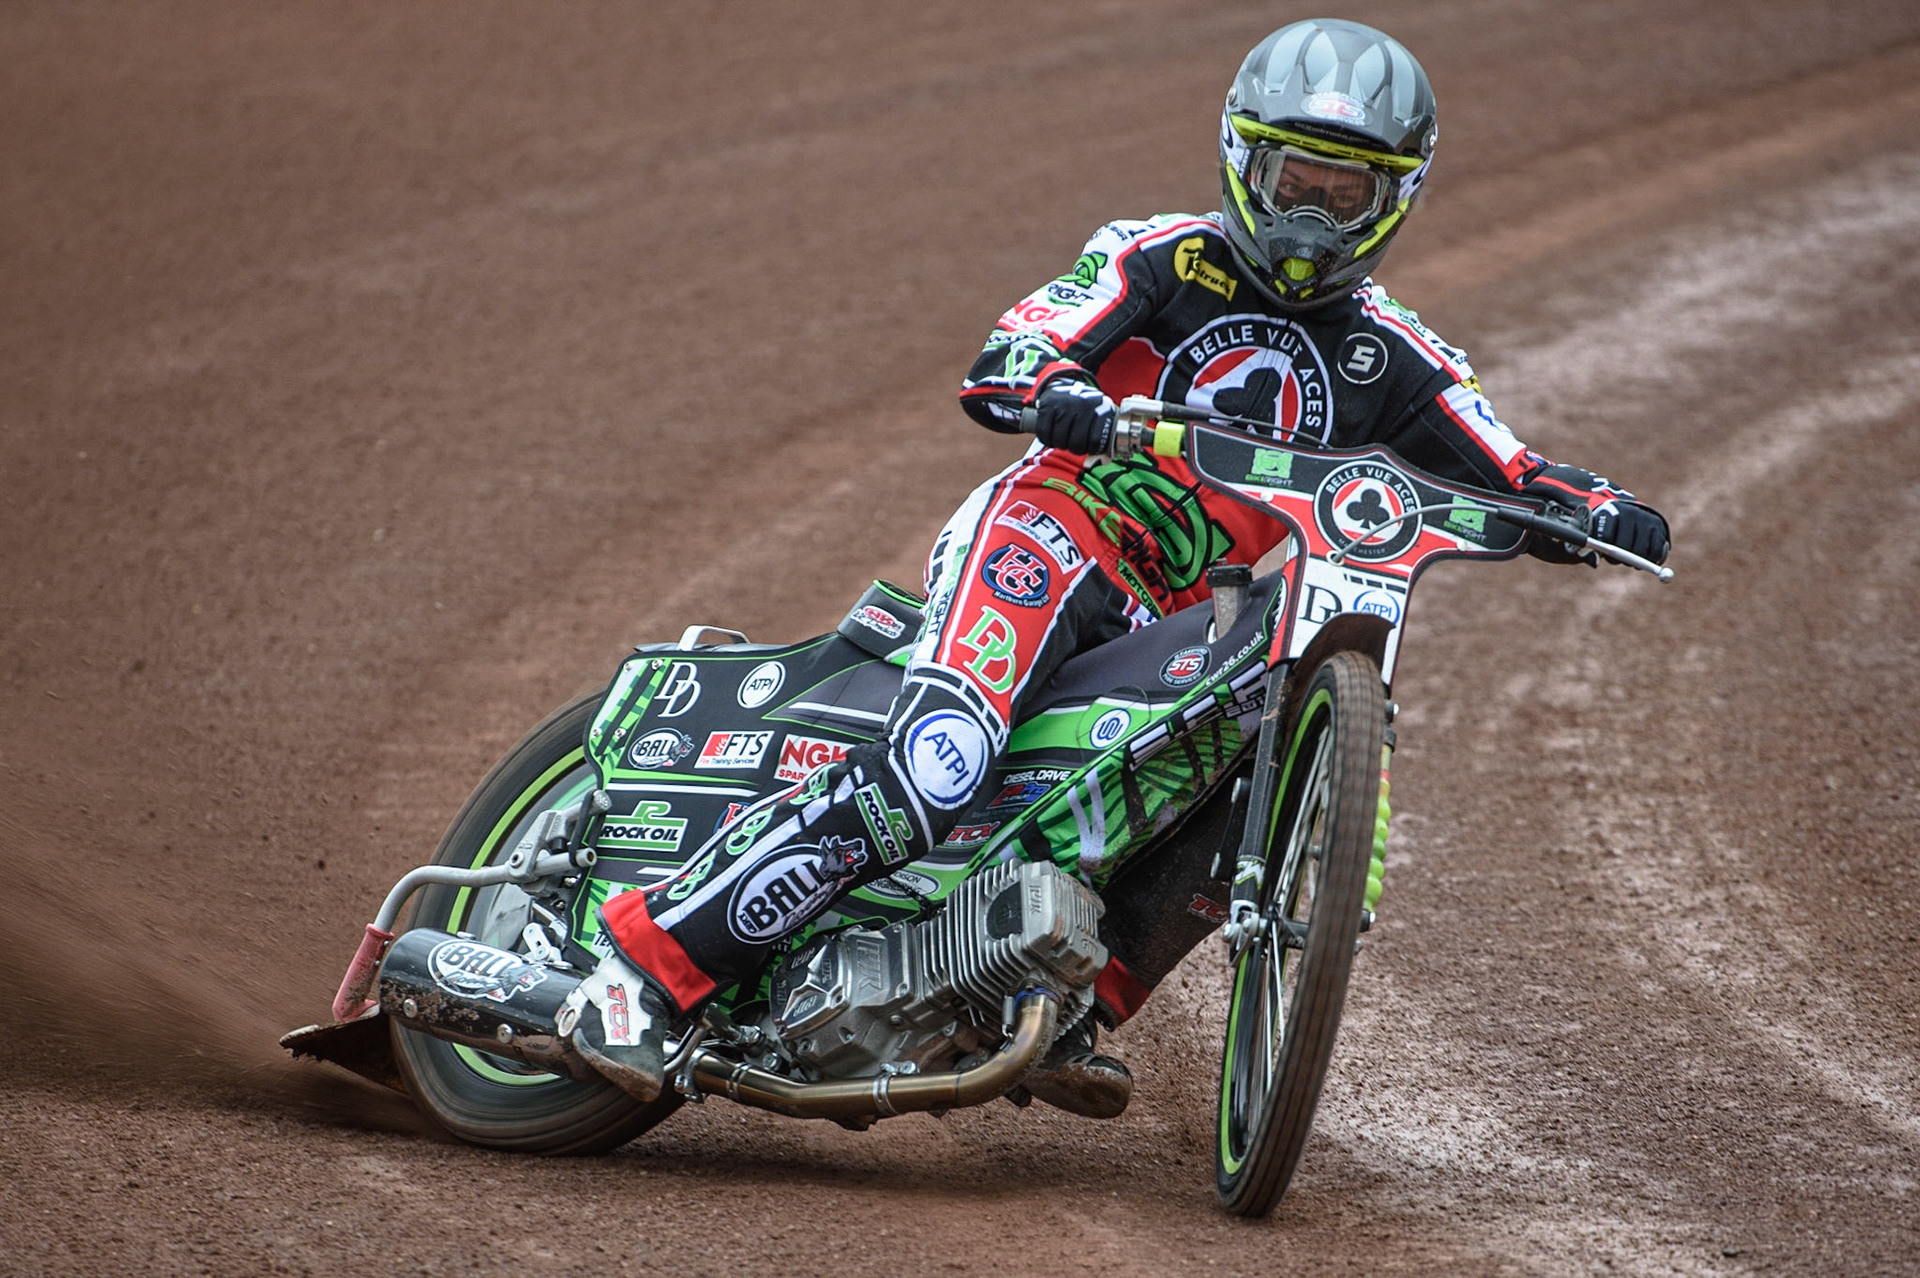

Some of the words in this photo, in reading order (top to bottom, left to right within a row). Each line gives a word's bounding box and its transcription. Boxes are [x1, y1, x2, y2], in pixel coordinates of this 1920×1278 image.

[1188, 325, 1255, 365] BELLE
[1298, 368, 1324, 429] ACES
[1325, 466, 1361, 494] BELLE
[1366, 466, 1393, 483] VUE
[1394, 482, 1416, 513] ACES
[1030, 508, 1080, 566] FTS
[1361, 602, 1393, 619] ATPI
[1169, 658, 1201, 672] STS
[746, 678, 777, 691] ATPI
[722, 733, 769, 756] FTS
[710, 757, 733, 766] Training
[733, 757, 756, 765] Services
[923, 731, 970, 787] ATPI
[778, 768, 807, 781] SPAR
[1003, 770, 1037, 785] DIESEL
[1036, 769, 1072, 781] DAVE
[600, 825, 651, 840] ROCK
[650, 827, 679, 842] OIL
[863, 790, 889, 839] ROCK
[884, 836, 900, 862] OIL
